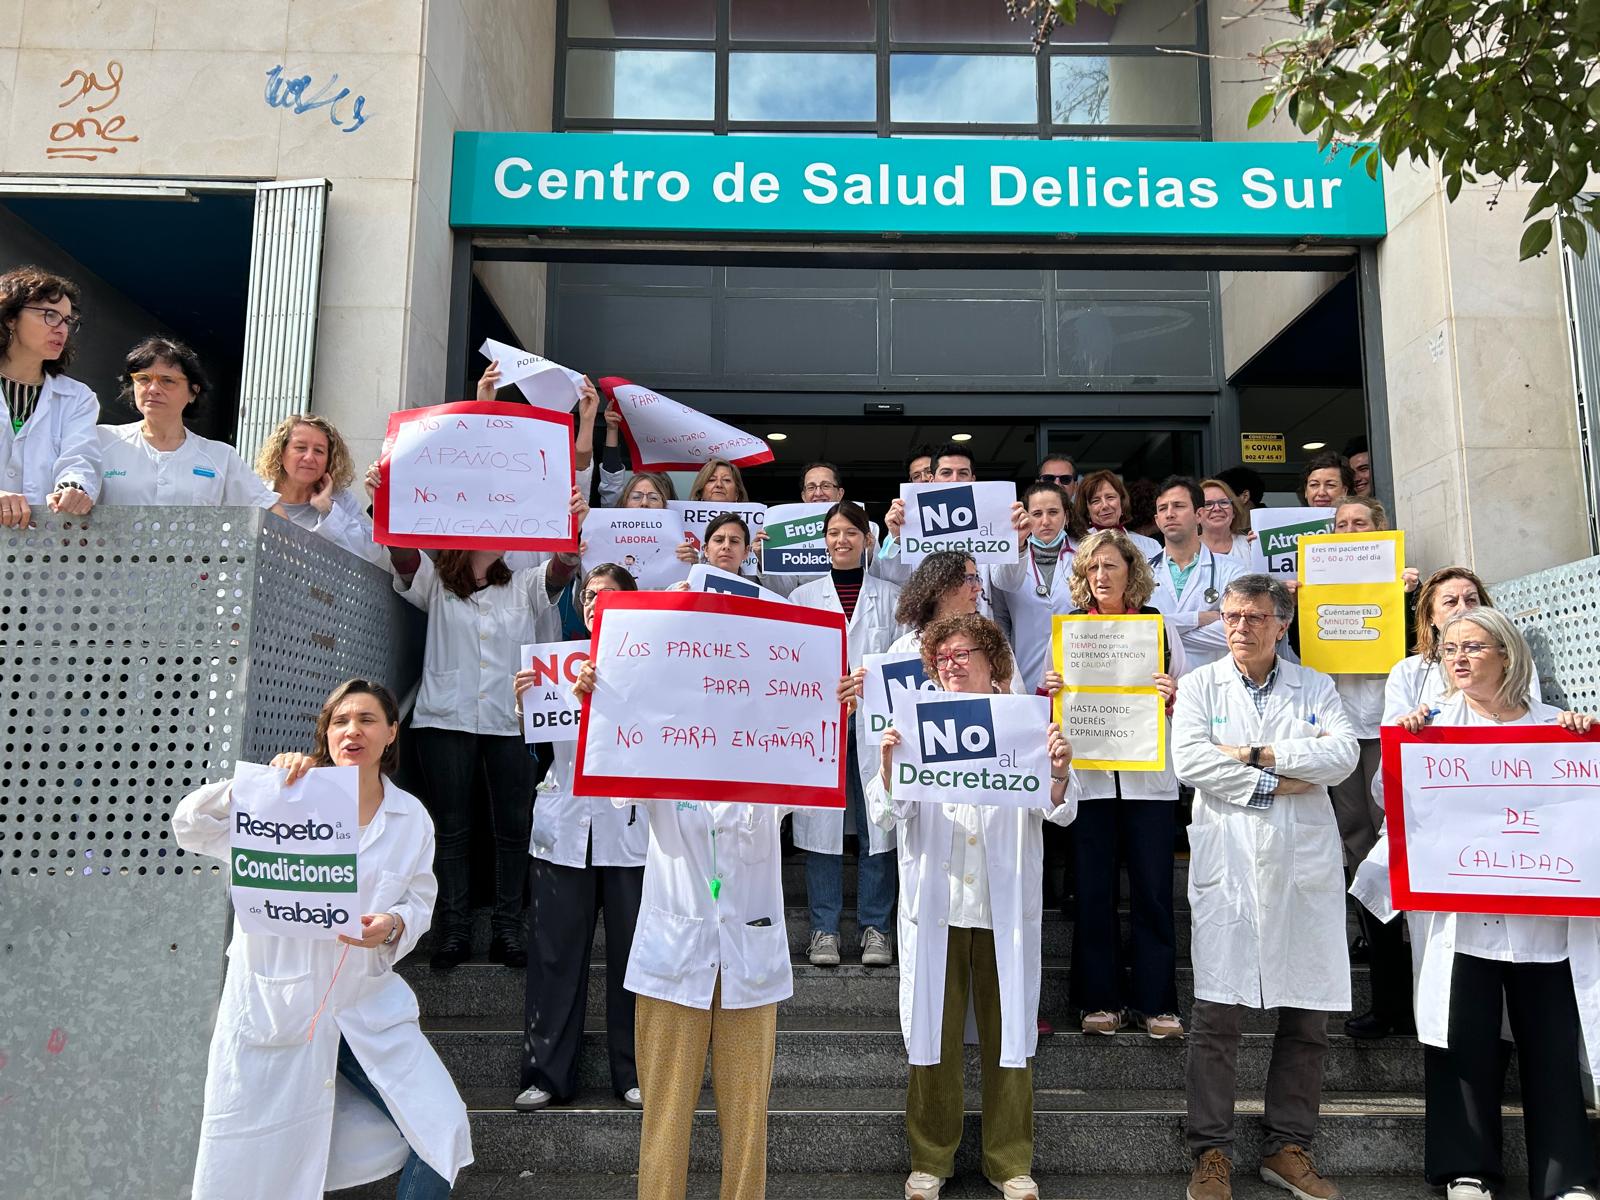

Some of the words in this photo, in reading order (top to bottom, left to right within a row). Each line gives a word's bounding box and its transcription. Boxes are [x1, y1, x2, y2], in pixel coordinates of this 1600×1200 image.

[494, 156, 690, 202] Centro
[712, 161, 780, 203] de
[802, 161, 965, 207] Salud
[990, 165, 1219, 209] Delicias
[1241, 167, 1343, 209] Sur
[629, 393, 660, 408] PARA
[417, 420, 440, 432] NO
[456, 420, 468, 429] A
[487, 418, 513, 429] LOS
[688, 446, 701, 456] NO
[1251, 444, 1282, 452] COVIAR
[104, 468, 127, 478] salud
[414, 487, 437, 503] NO
[456, 491, 467, 502] A
[489, 493, 516, 503] LOS
[610, 520, 663, 529] ATROPELLO
[684, 509, 765, 525] RESTO
[921, 503, 973, 532] No
[979, 522, 994, 537] al
[784, 521, 824, 538] Enga
[615, 535, 659, 544] LABORAL
[906, 537, 1011, 553] Decretazo
[1339, 544, 1369, 554] paciente
[616, 632, 651, 658] LOS
[666, 640, 750, 659] PARCHES
[768, 641, 806, 663] SON
[544, 691, 558, 701] AL
[703, 676, 750, 696] PARA
[765, 679, 823, 701] SANAR
[1070, 704, 1098, 714] HASTA
[1100, 705, 1130, 714] DONDE
[616, 723, 643, 749] NO
[662, 725, 717, 749] PARA
[1070, 728, 1128, 738] EXPRIMIRNOS
[922, 718, 990, 756] No
[999, 749, 1018, 768] al
[1423, 756, 1470, 782] POR
[1491, 758, 1533, 780] UNA
[899, 763, 1040, 792] Decretazo
[678, 800, 698, 811] salud
[1504, 807, 1540, 828] DE
[236, 811, 333, 845] Respeto
[335, 821, 342, 829] a
[336, 831, 351, 840] las
[235, 854, 354, 883] Condiciones
[249, 906, 262, 914] de
[264, 899, 349, 929] trabajo
